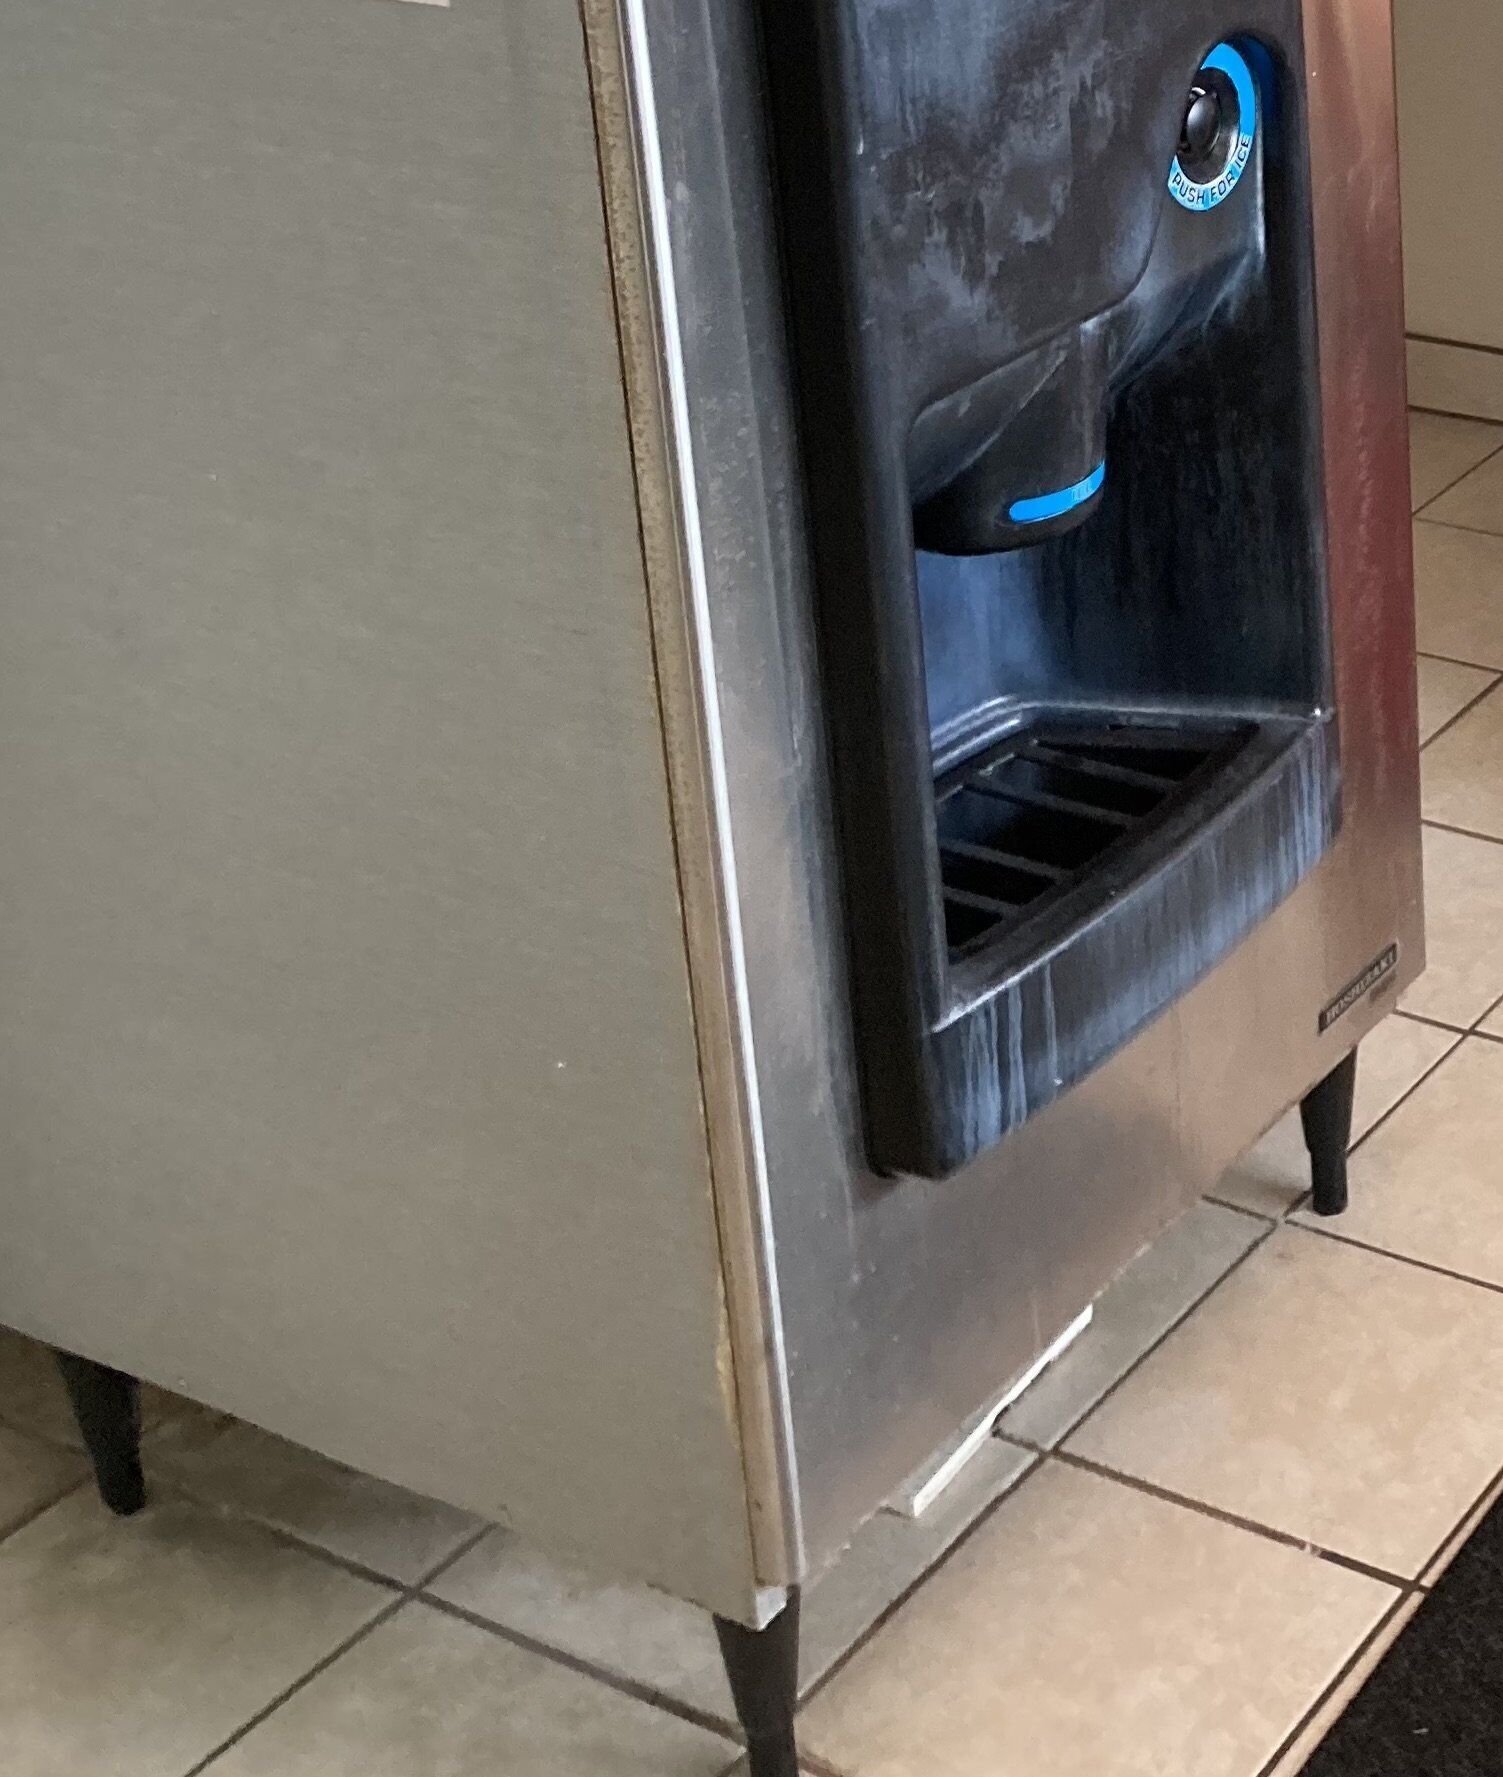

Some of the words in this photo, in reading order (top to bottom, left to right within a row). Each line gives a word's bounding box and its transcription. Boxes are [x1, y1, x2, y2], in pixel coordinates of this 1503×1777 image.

[1172, 172, 1205, 204] PUSH
[1210, 171, 1236, 202] FOR
[1235, 135, 1250, 170] ICE
